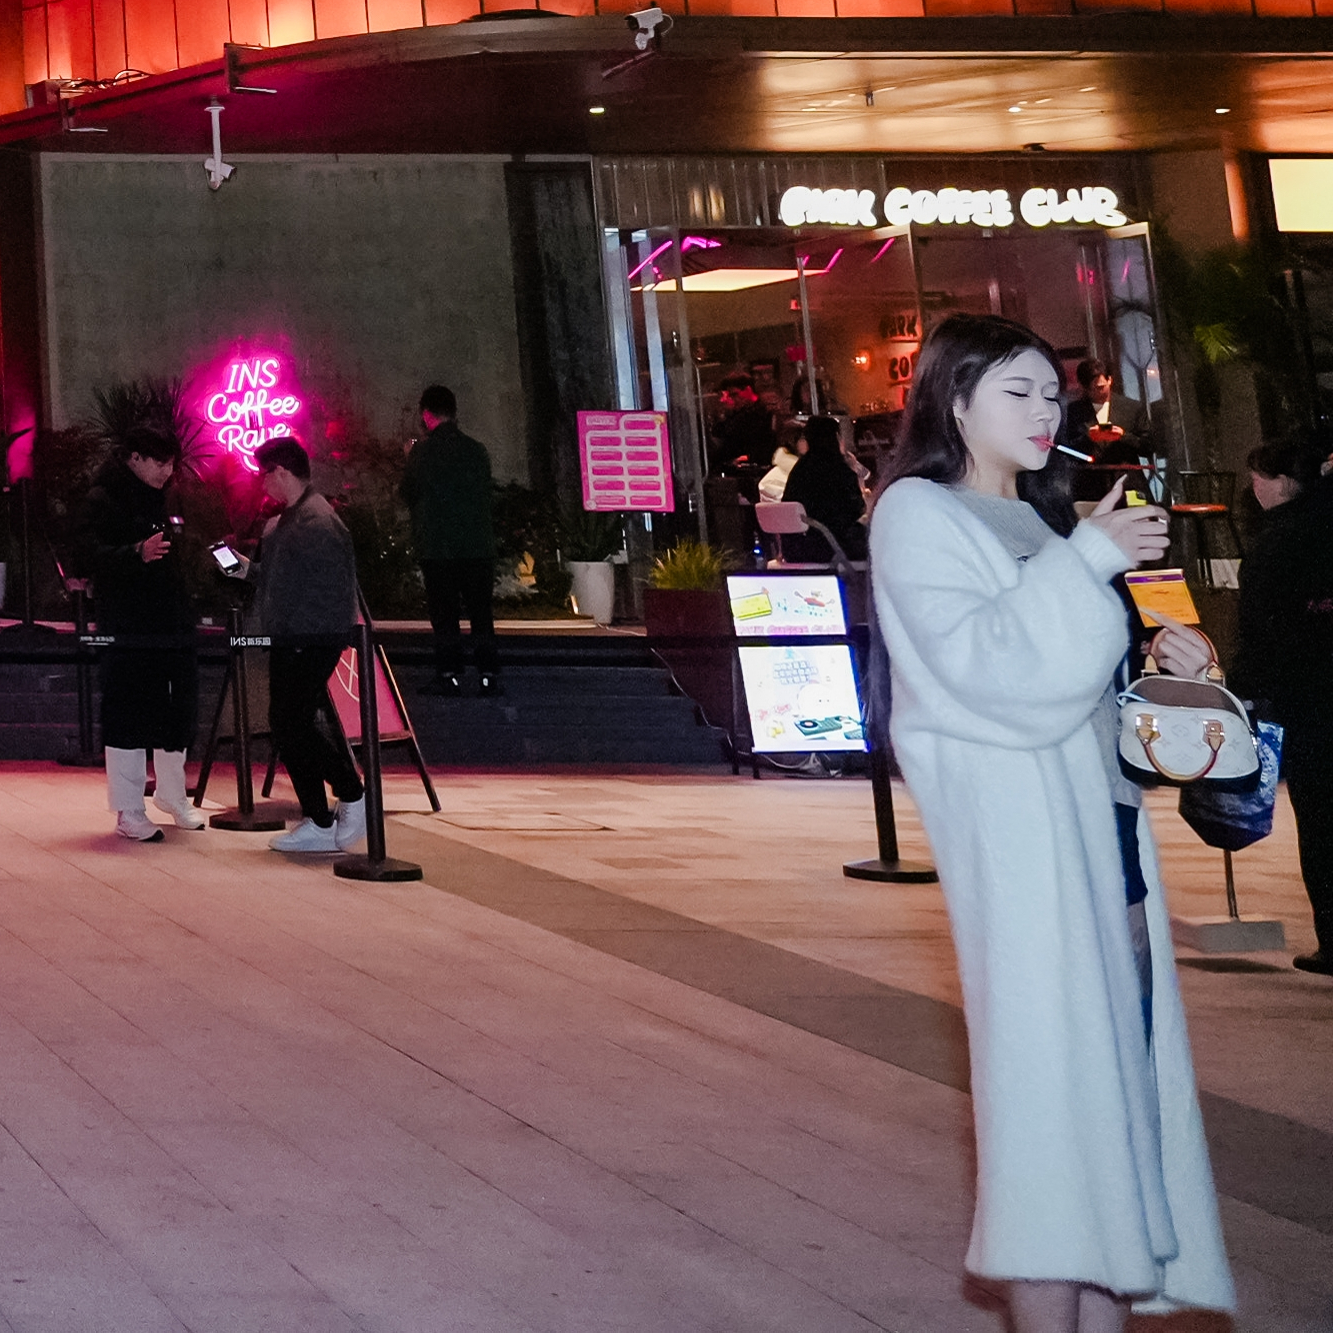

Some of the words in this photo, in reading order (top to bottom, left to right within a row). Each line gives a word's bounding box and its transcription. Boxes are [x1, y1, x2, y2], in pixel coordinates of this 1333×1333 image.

[883, 188, 1015, 227] COFFEE
[1020, 186, 1127, 227] CLUB
[225, 359, 279, 393] INS
[208, 389, 300, 429] Coffee
